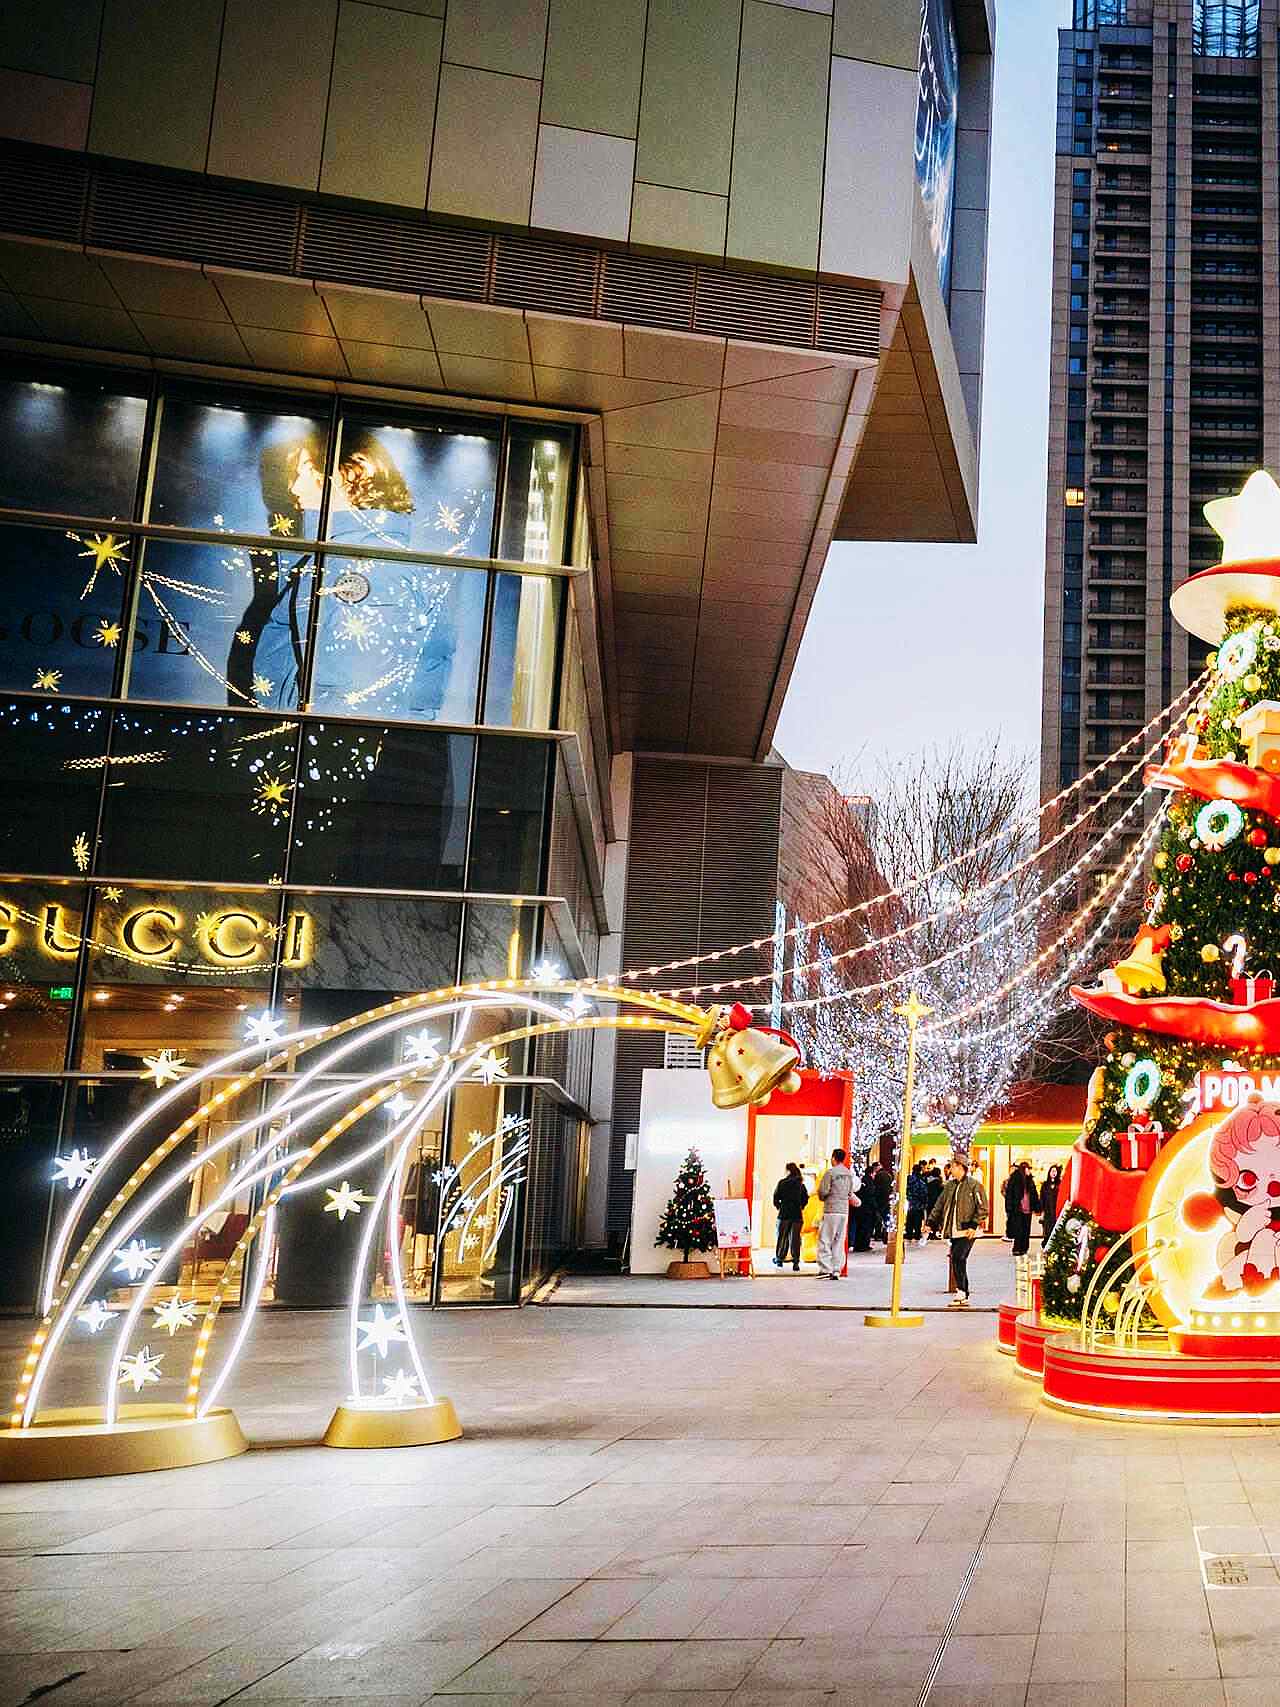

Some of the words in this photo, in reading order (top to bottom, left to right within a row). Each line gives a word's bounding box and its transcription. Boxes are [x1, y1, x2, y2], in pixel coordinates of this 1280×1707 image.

[0, 609, 192, 656] OOSE
[0, 896, 305, 962] UCCI
[1204, 1075, 1256, 1109] POP
